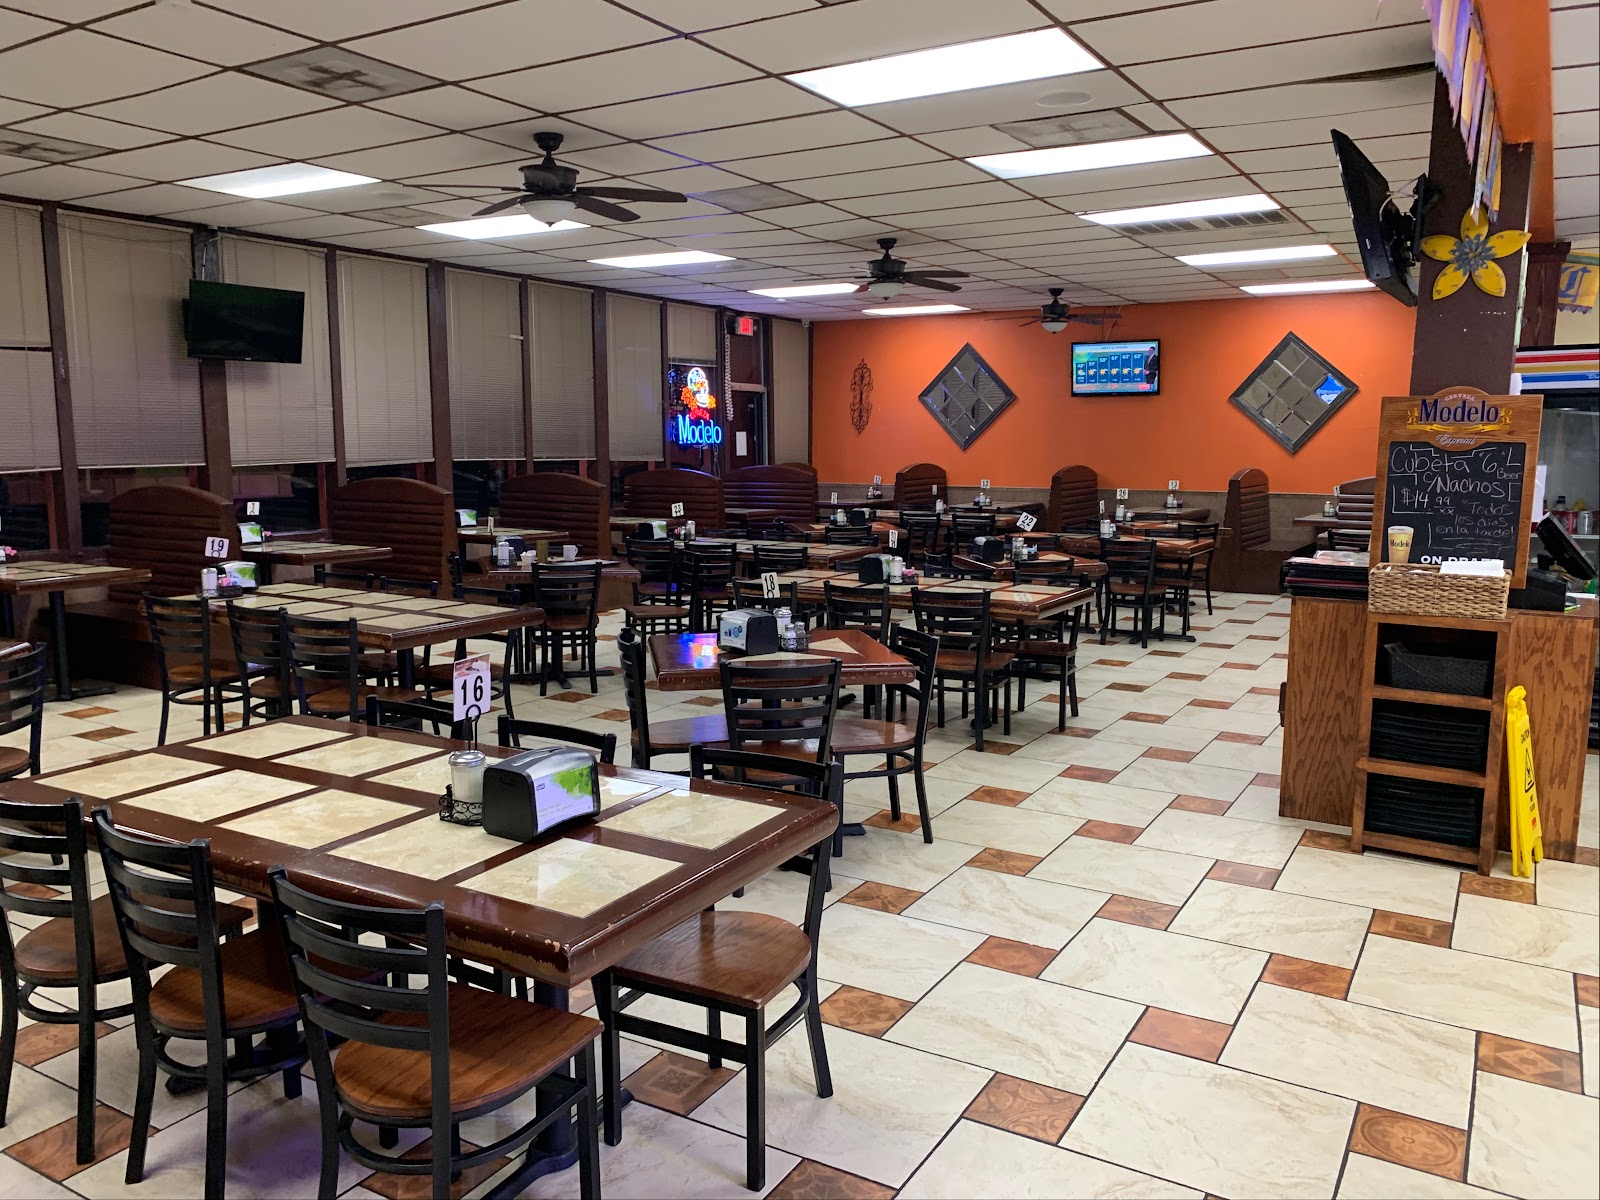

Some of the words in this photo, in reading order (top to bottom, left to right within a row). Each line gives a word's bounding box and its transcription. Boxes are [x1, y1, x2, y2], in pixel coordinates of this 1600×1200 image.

[1419, 399, 1499, 423] Modelo
[677, 414, 722, 444] Modelo
[1391, 447, 1470, 473] Cubeta
[1497, 468, 1522, 480] Beer
[1021, 515, 1034, 527] 22
[211, 539, 224, 552] 19
[1420, 555, 1442, 565] ON
[764, 574, 776, 591] 18
[461, 675, 484, 706] 16
